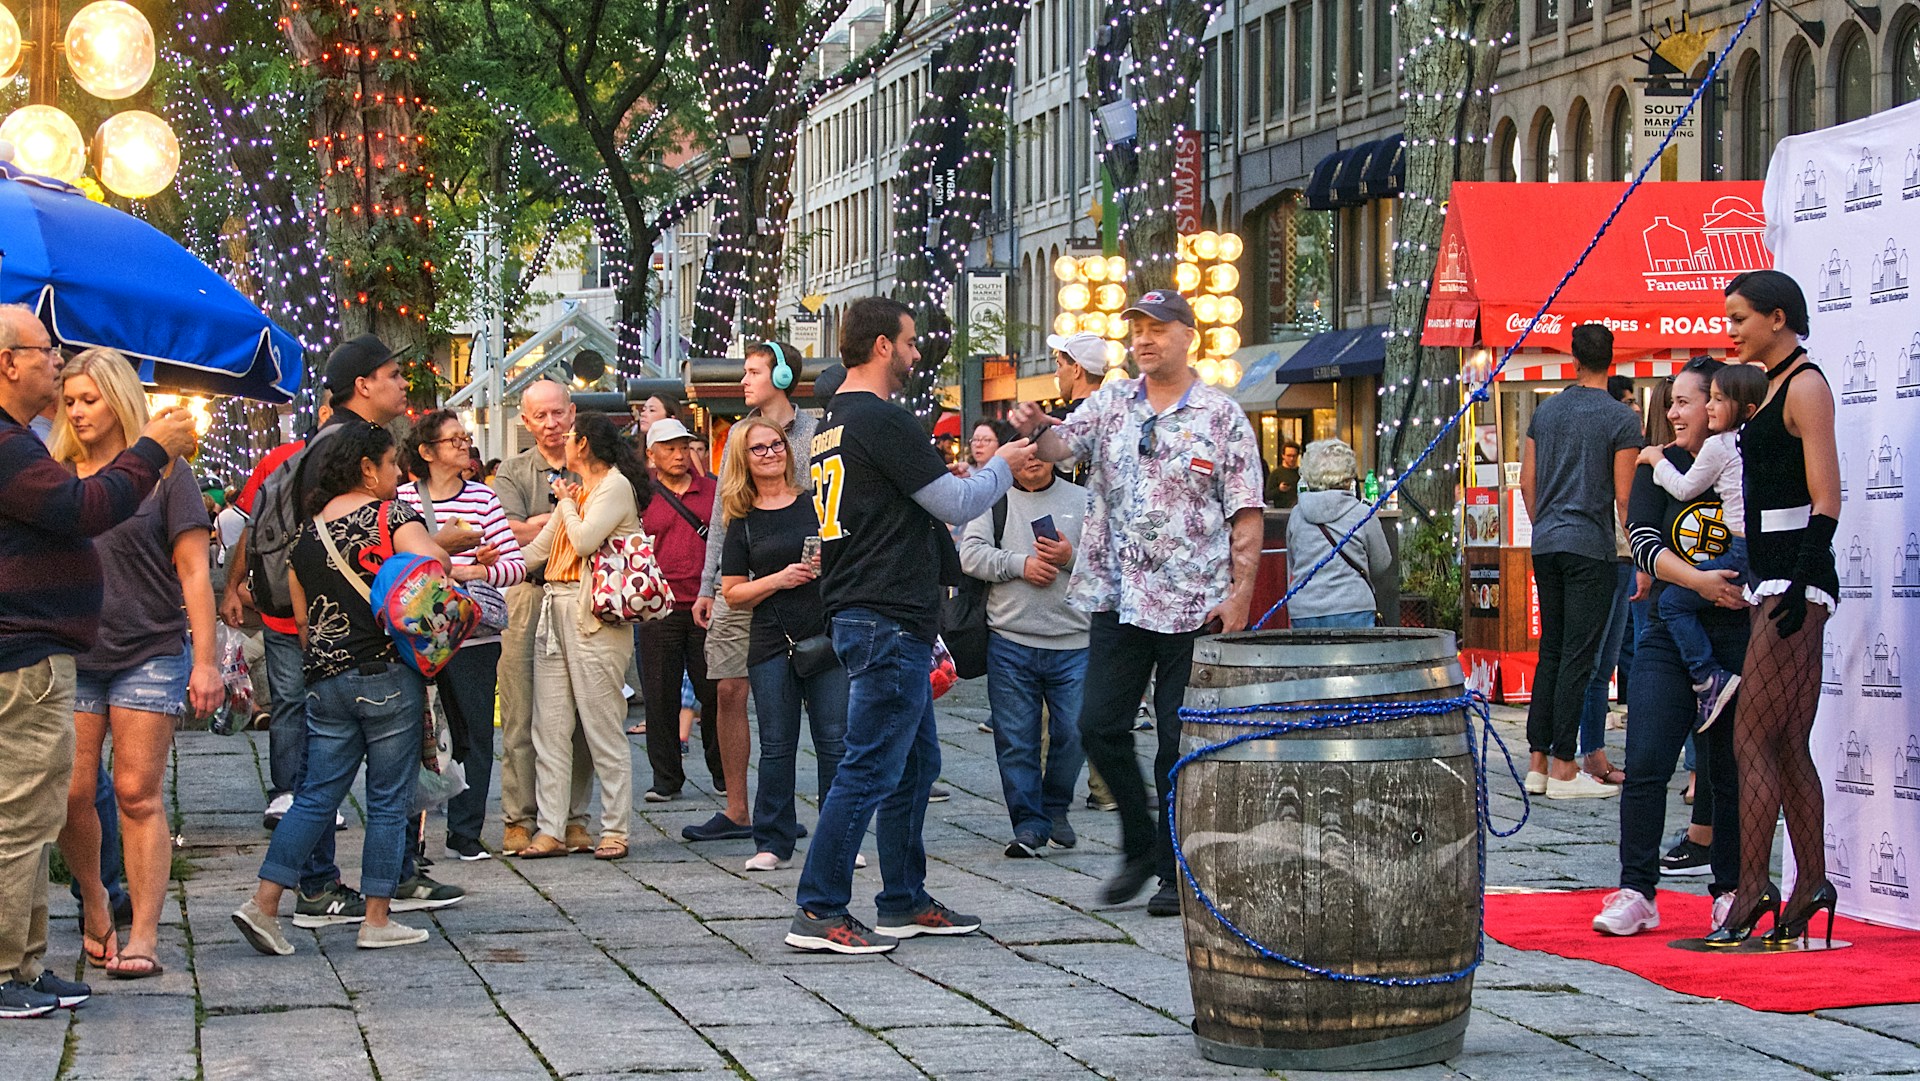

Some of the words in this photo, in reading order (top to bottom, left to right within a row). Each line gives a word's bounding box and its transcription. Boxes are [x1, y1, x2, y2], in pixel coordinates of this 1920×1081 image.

[1644, 118, 1695, 127] MARKET
[946, 168, 956, 201] RBAN
[1645, 277, 1708, 291] Faneuil
[1711, 276, 1737, 290] Ha
[1506, 312, 1565, 334] CocaCola
[810, 454, 845, 542] 37
[326, 900, 346, 914] N
